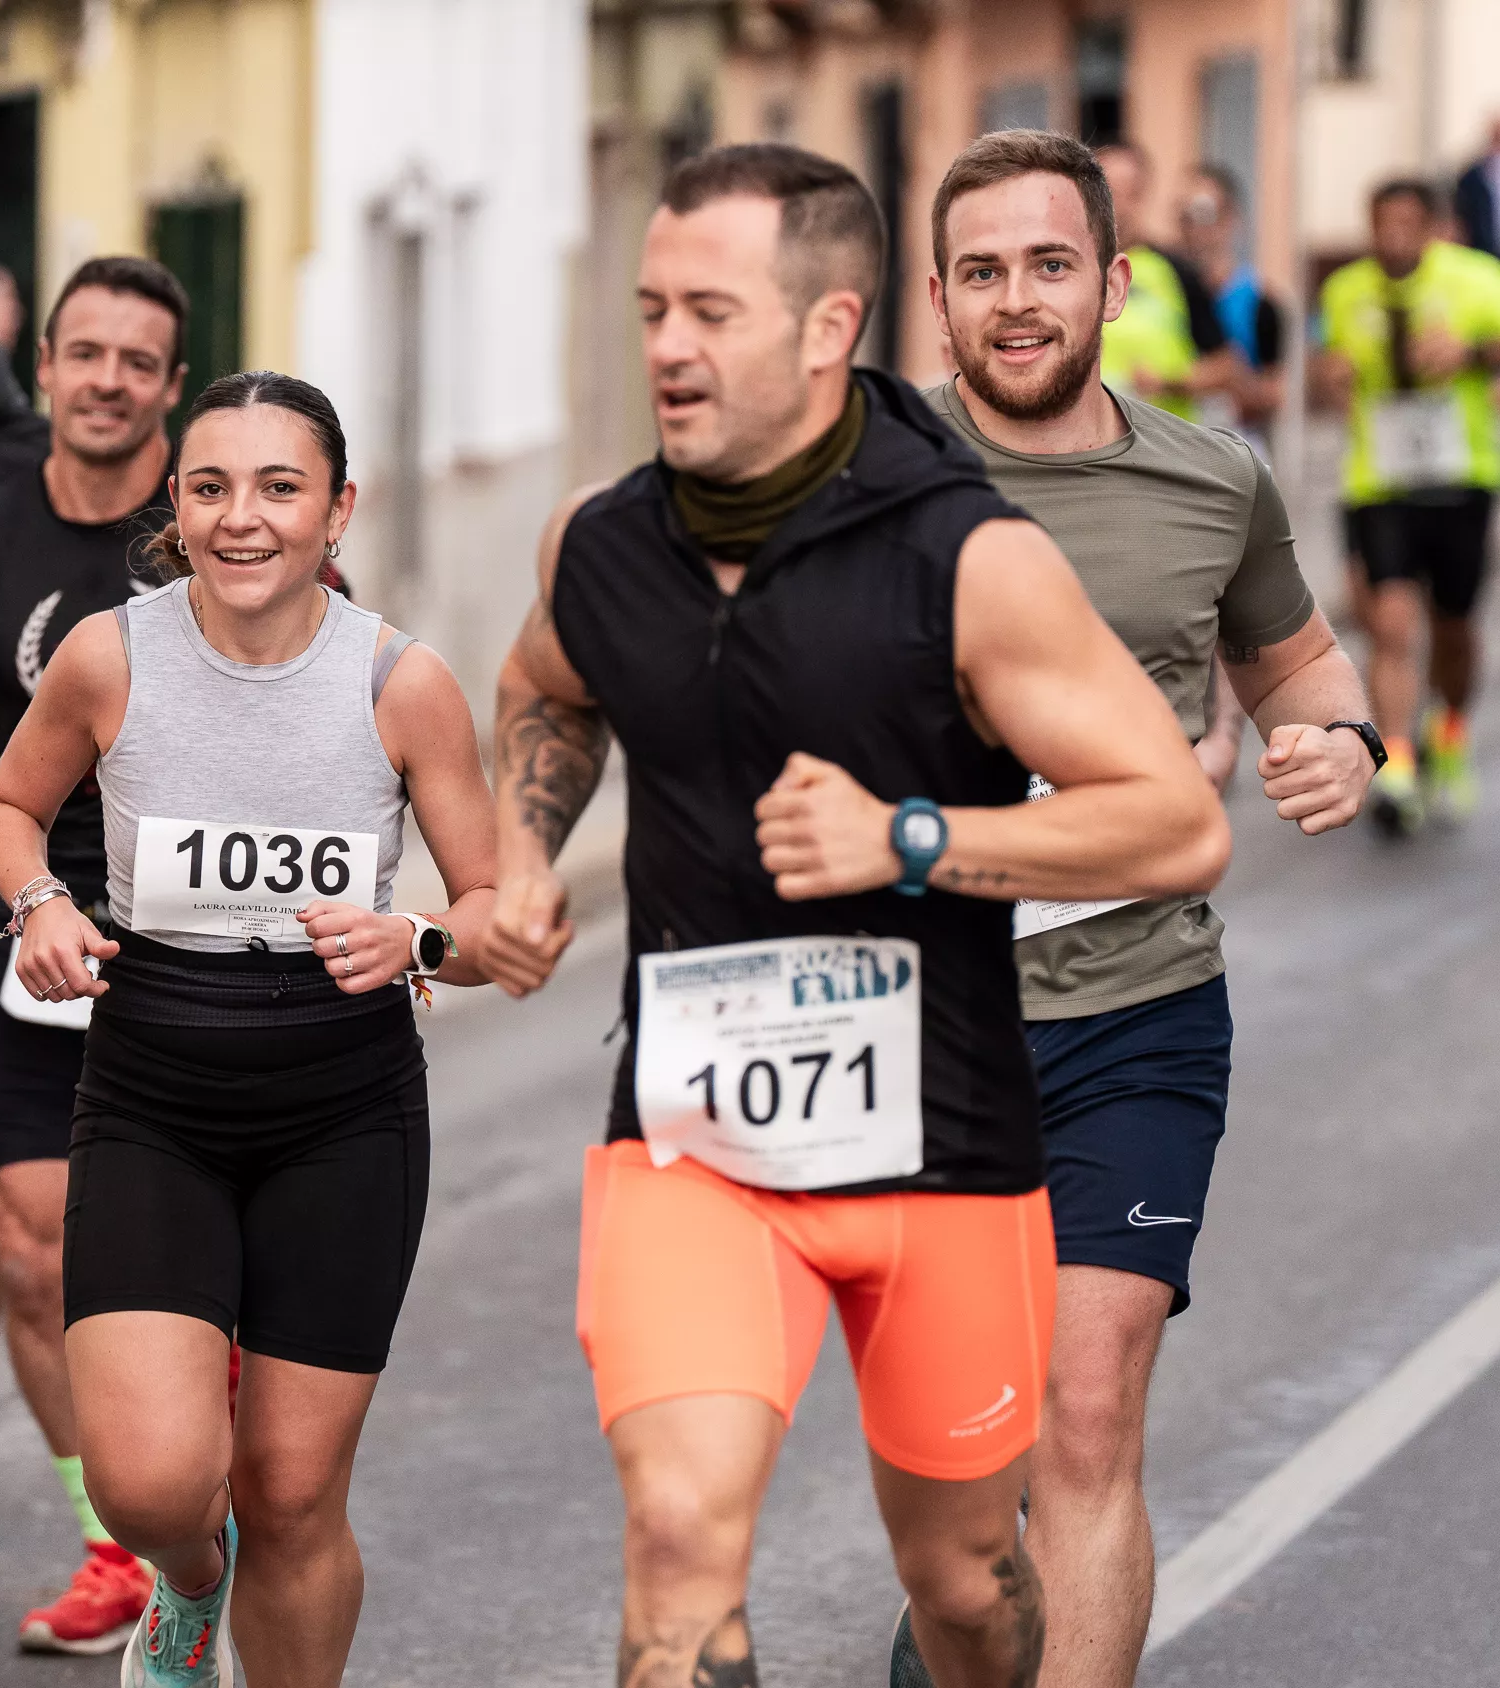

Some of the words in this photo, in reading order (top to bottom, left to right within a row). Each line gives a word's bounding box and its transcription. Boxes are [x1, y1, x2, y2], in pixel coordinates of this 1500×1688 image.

[177, 829, 350, 895] 1036
[194, 903, 226, 911] LAURA
[228, 904, 278, 913] CALVILLO
[687, 1043, 875, 1126] 1071
